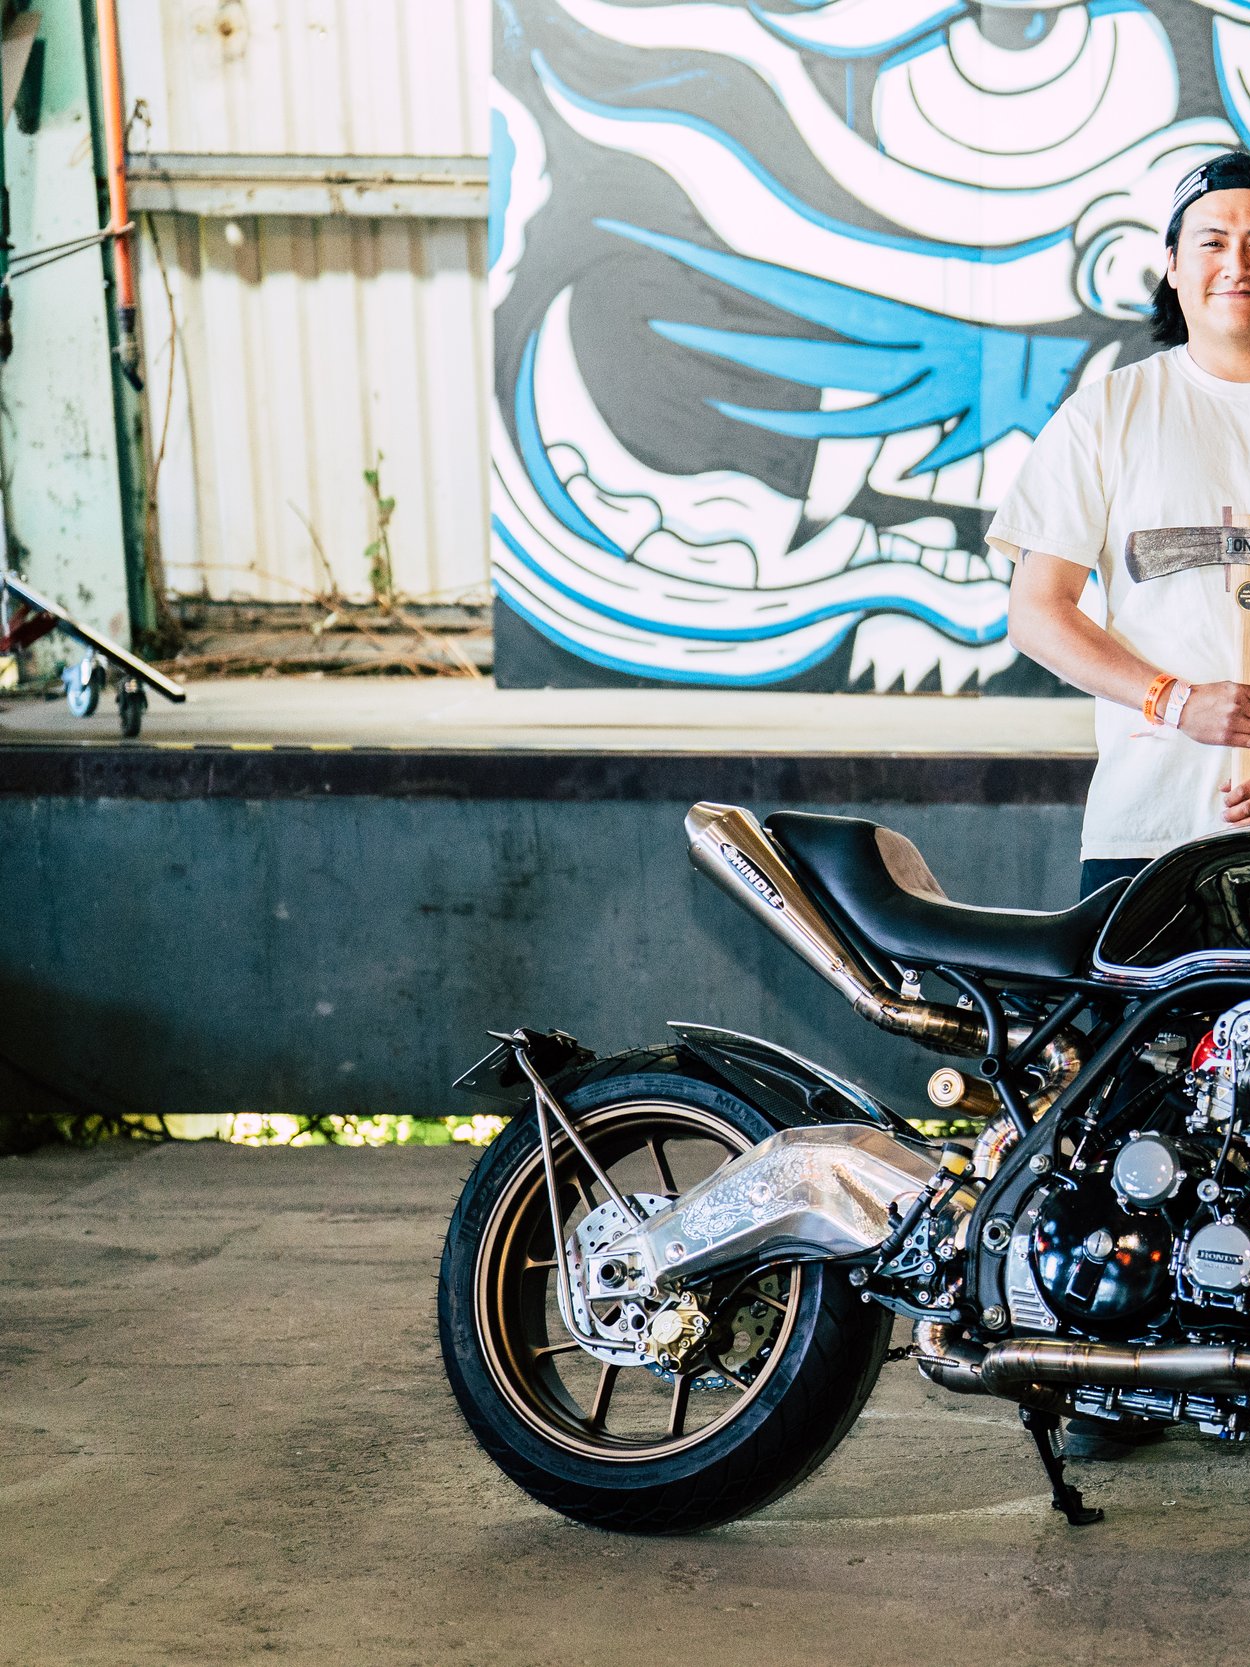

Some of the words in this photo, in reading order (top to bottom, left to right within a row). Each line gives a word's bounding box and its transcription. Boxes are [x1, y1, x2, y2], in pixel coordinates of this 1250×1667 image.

[731, 855, 783, 907] HINDLE
[714, 1091, 774, 1138] MUTAN
[1200, 1251, 1240, 1263] HONDA
